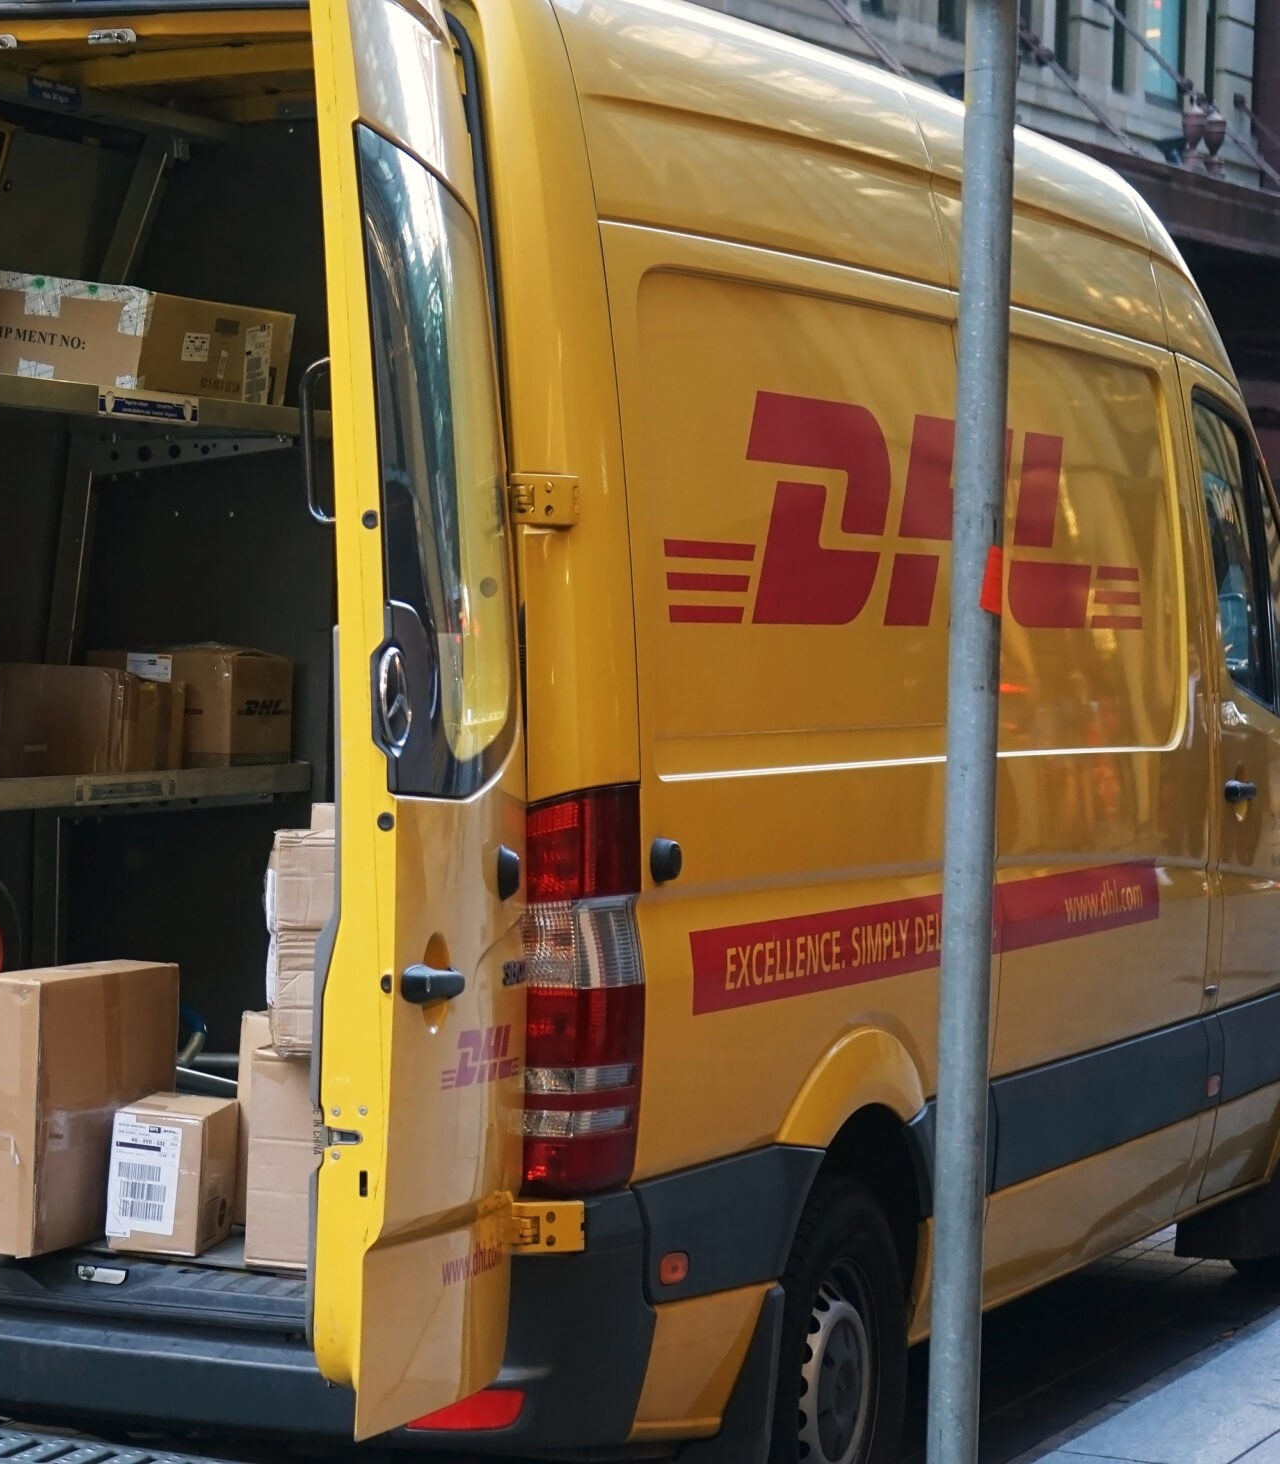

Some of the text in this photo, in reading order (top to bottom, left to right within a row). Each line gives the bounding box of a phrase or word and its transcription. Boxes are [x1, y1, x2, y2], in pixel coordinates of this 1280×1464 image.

[242, 699, 284, 717] DHL
[1065, 881, 1144, 925] www.dhl.com
[724, 929, 847, 991] EXCELLENCE.
[850, 917, 909, 969] SIMPLY
[455, 1024, 513, 1089] DHL
[312, 1130, 323, 1156] CHINA
